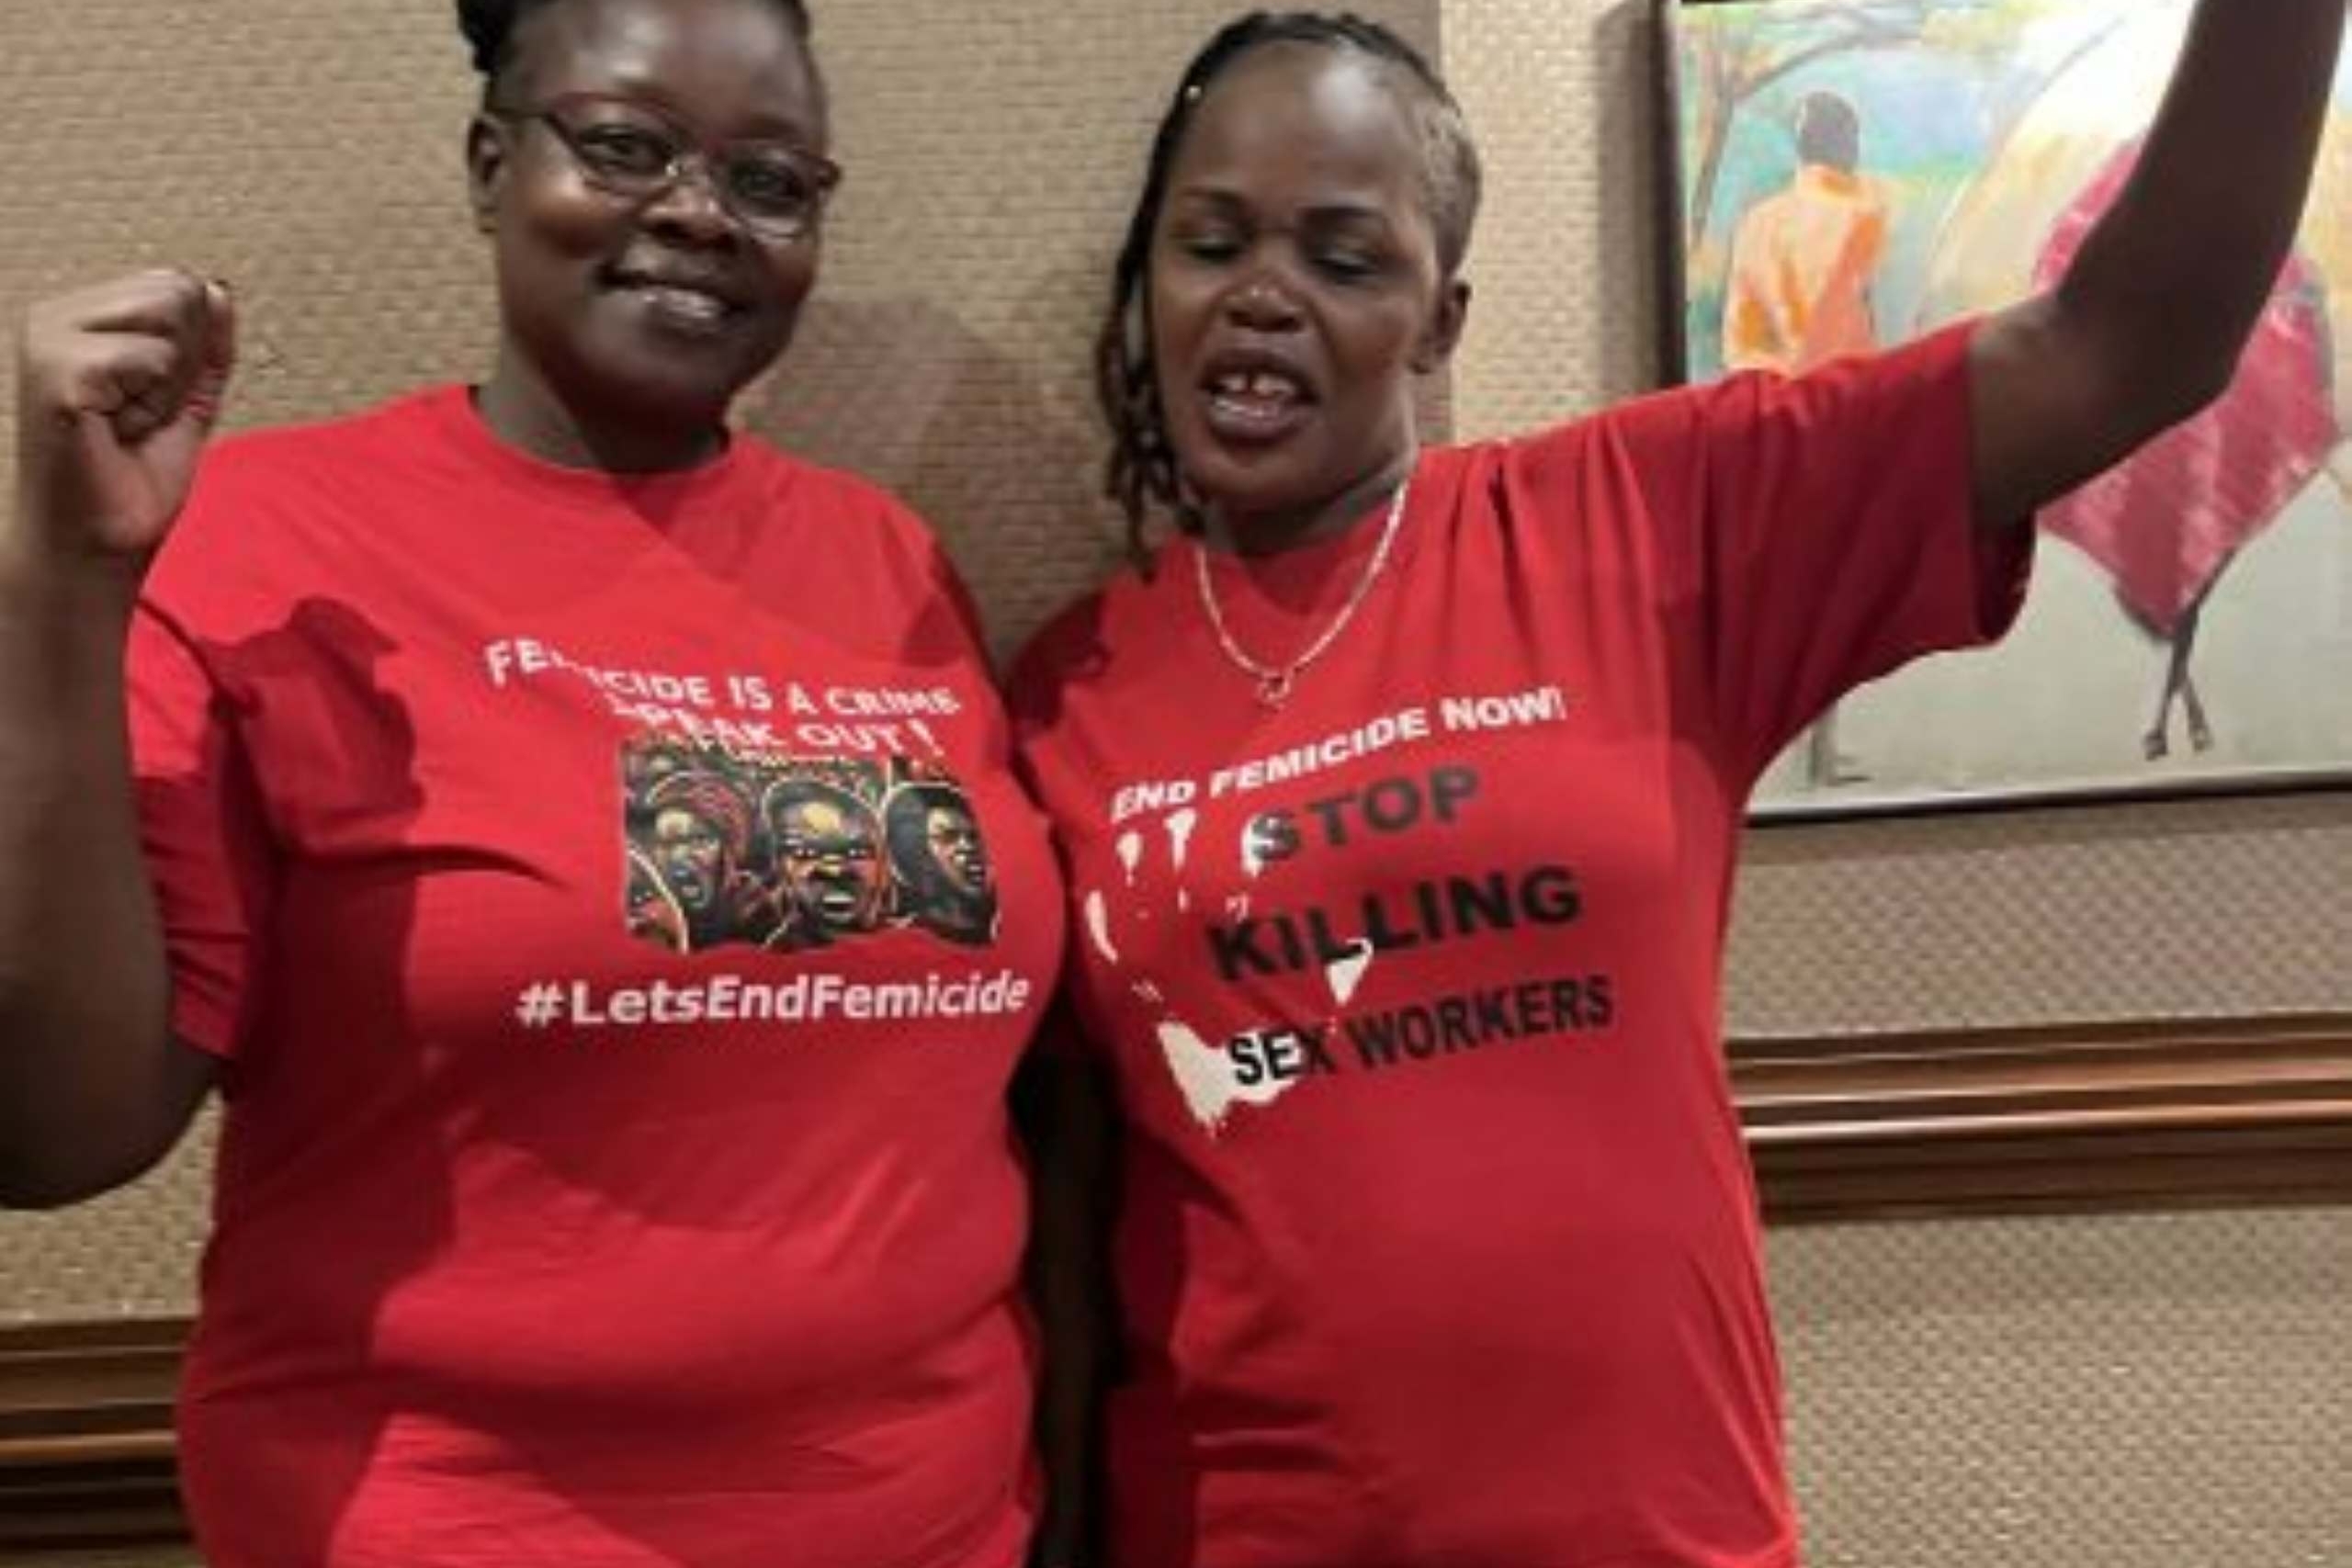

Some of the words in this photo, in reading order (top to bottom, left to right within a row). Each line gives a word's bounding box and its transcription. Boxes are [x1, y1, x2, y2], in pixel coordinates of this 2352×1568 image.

[603, 691, 788, 753] PEAK
[796, 717, 946, 757] OUT!
[728, 674, 774, 712] IS
[787, 682, 820, 716] A
[827, 686, 962, 716] CRIME
[1110, 779, 1197, 825] END
[1208, 707, 1432, 800] FEMICIDE
[1250, 764, 1482, 863] STOP
[1204, 865, 1583, 982] KILLING
[516, 969, 1031, 1025] #LetsEndFemicide
[1229, 1023, 1338, 1086] SEX
[1349, 974, 1613, 1068] WORKERS
